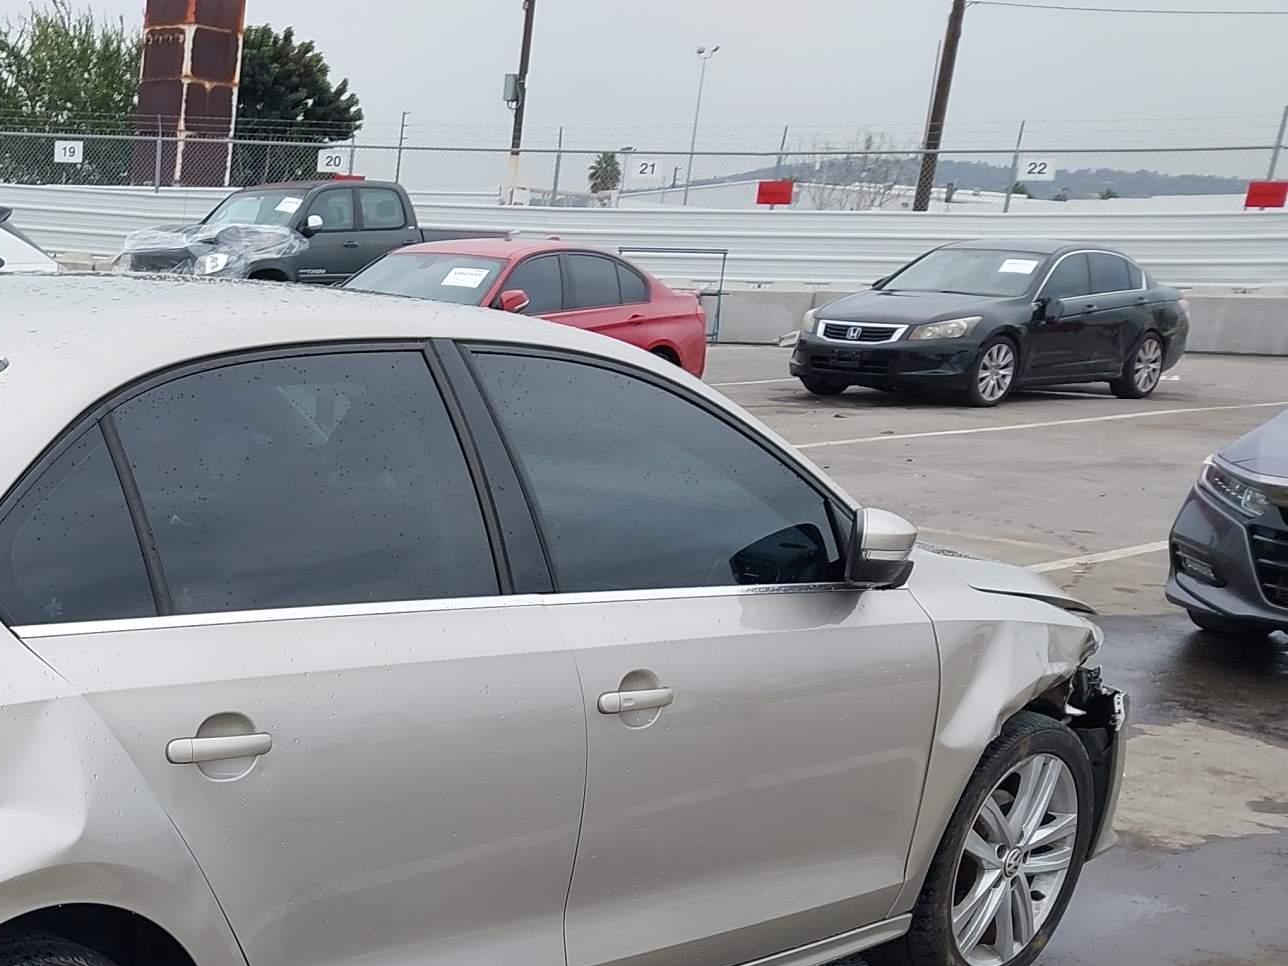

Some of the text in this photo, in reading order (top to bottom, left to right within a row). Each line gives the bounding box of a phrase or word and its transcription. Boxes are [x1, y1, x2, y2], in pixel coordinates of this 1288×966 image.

[61, 146, 76, 158] 19
[325, 155, 342, 167] 20
[639, 162, 656, 175] 21
[1027, 162, 1048, 175] 22
